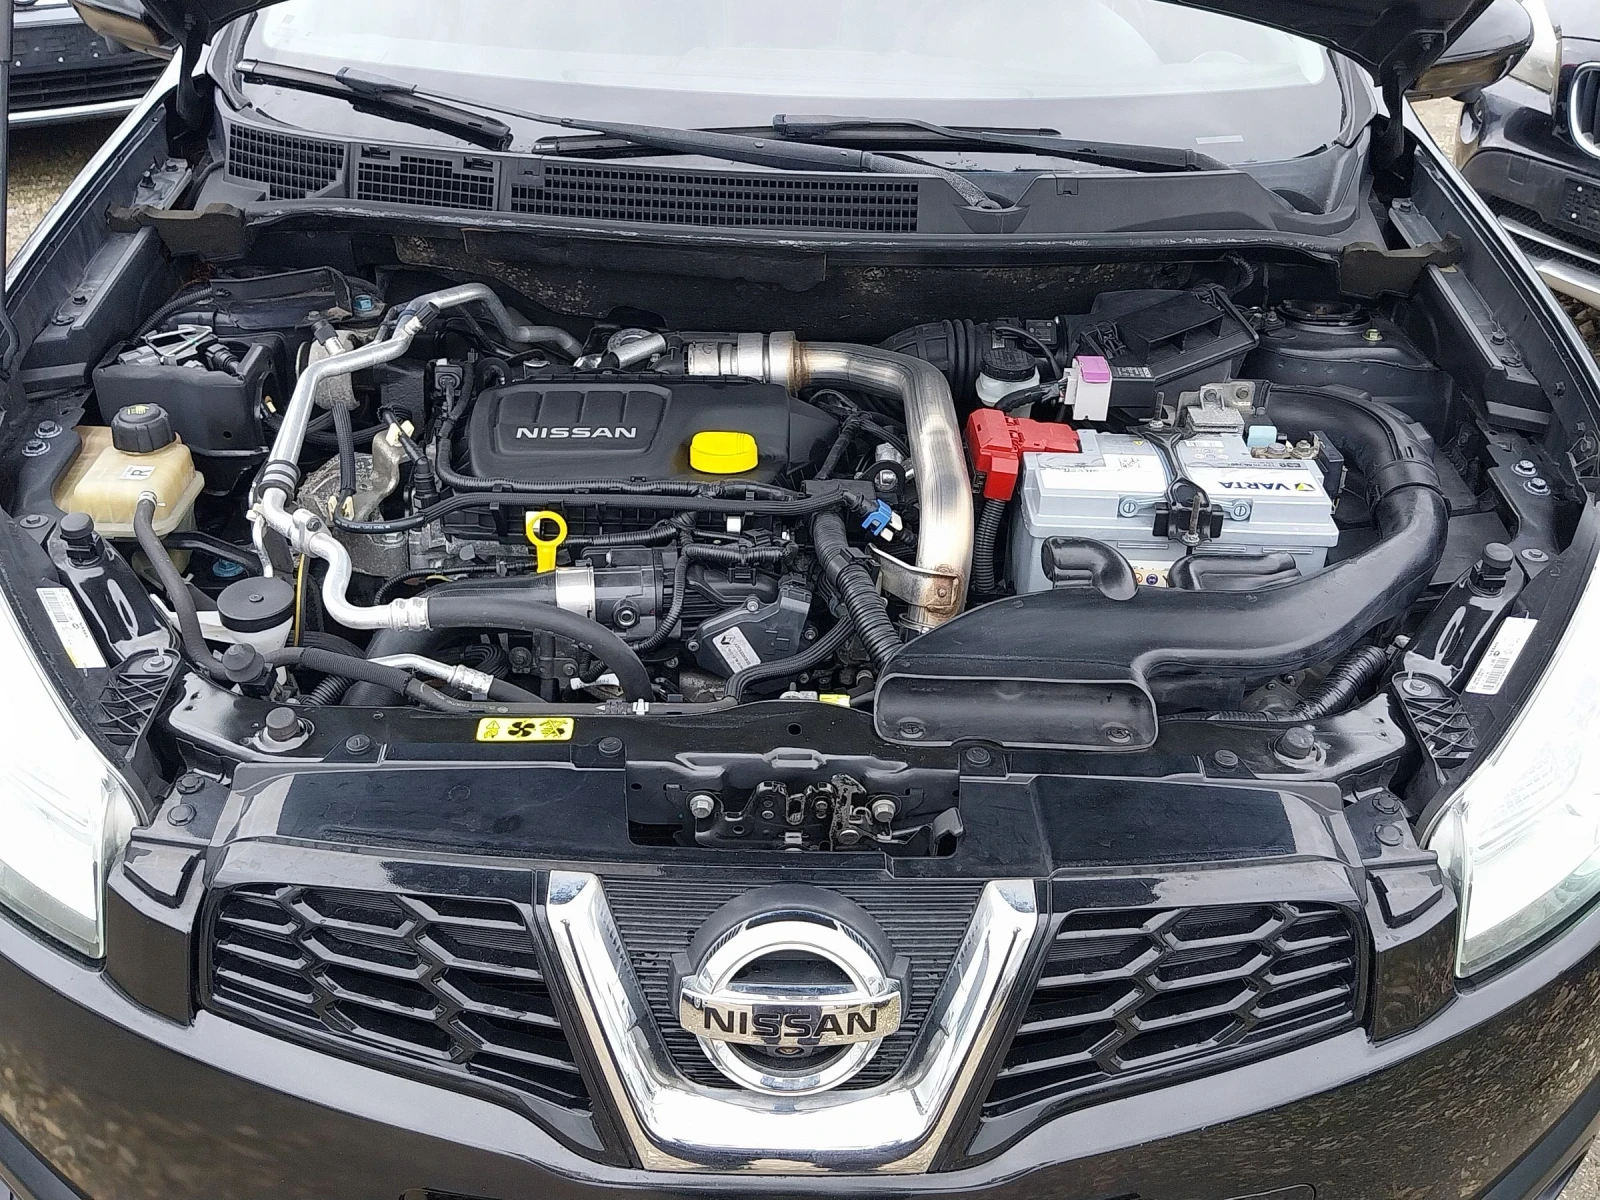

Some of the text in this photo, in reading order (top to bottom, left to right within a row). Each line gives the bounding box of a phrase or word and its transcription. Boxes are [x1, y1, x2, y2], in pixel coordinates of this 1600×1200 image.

[516, 426, 637, 439] NISSAN
[1218, 481, 1291, 491] VARTA
[703, 1006, 878, 1039] NISSAN
